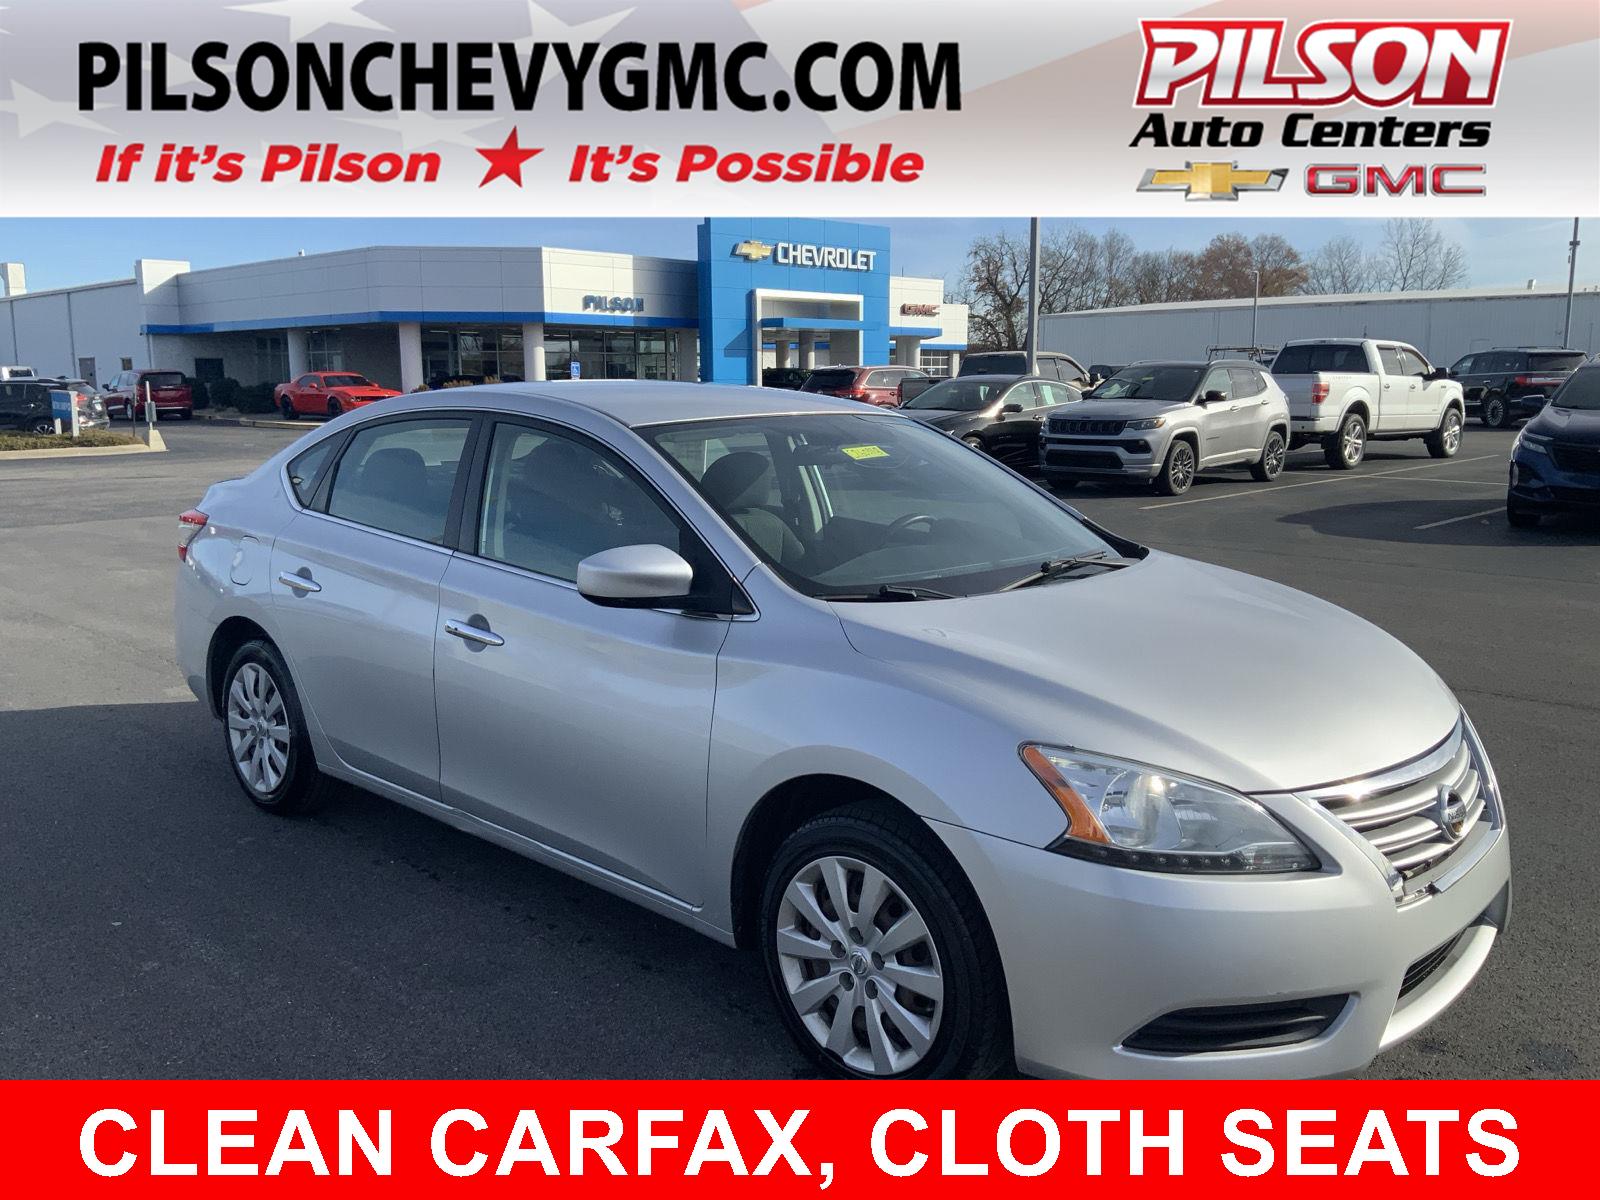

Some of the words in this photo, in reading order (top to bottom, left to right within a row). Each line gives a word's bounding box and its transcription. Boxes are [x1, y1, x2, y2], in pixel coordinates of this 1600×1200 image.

[777, 242, 877, 270] CHEVROLET
[582, 294, 644, 312] PILSON
[902, 303, 940, 315] GMC
